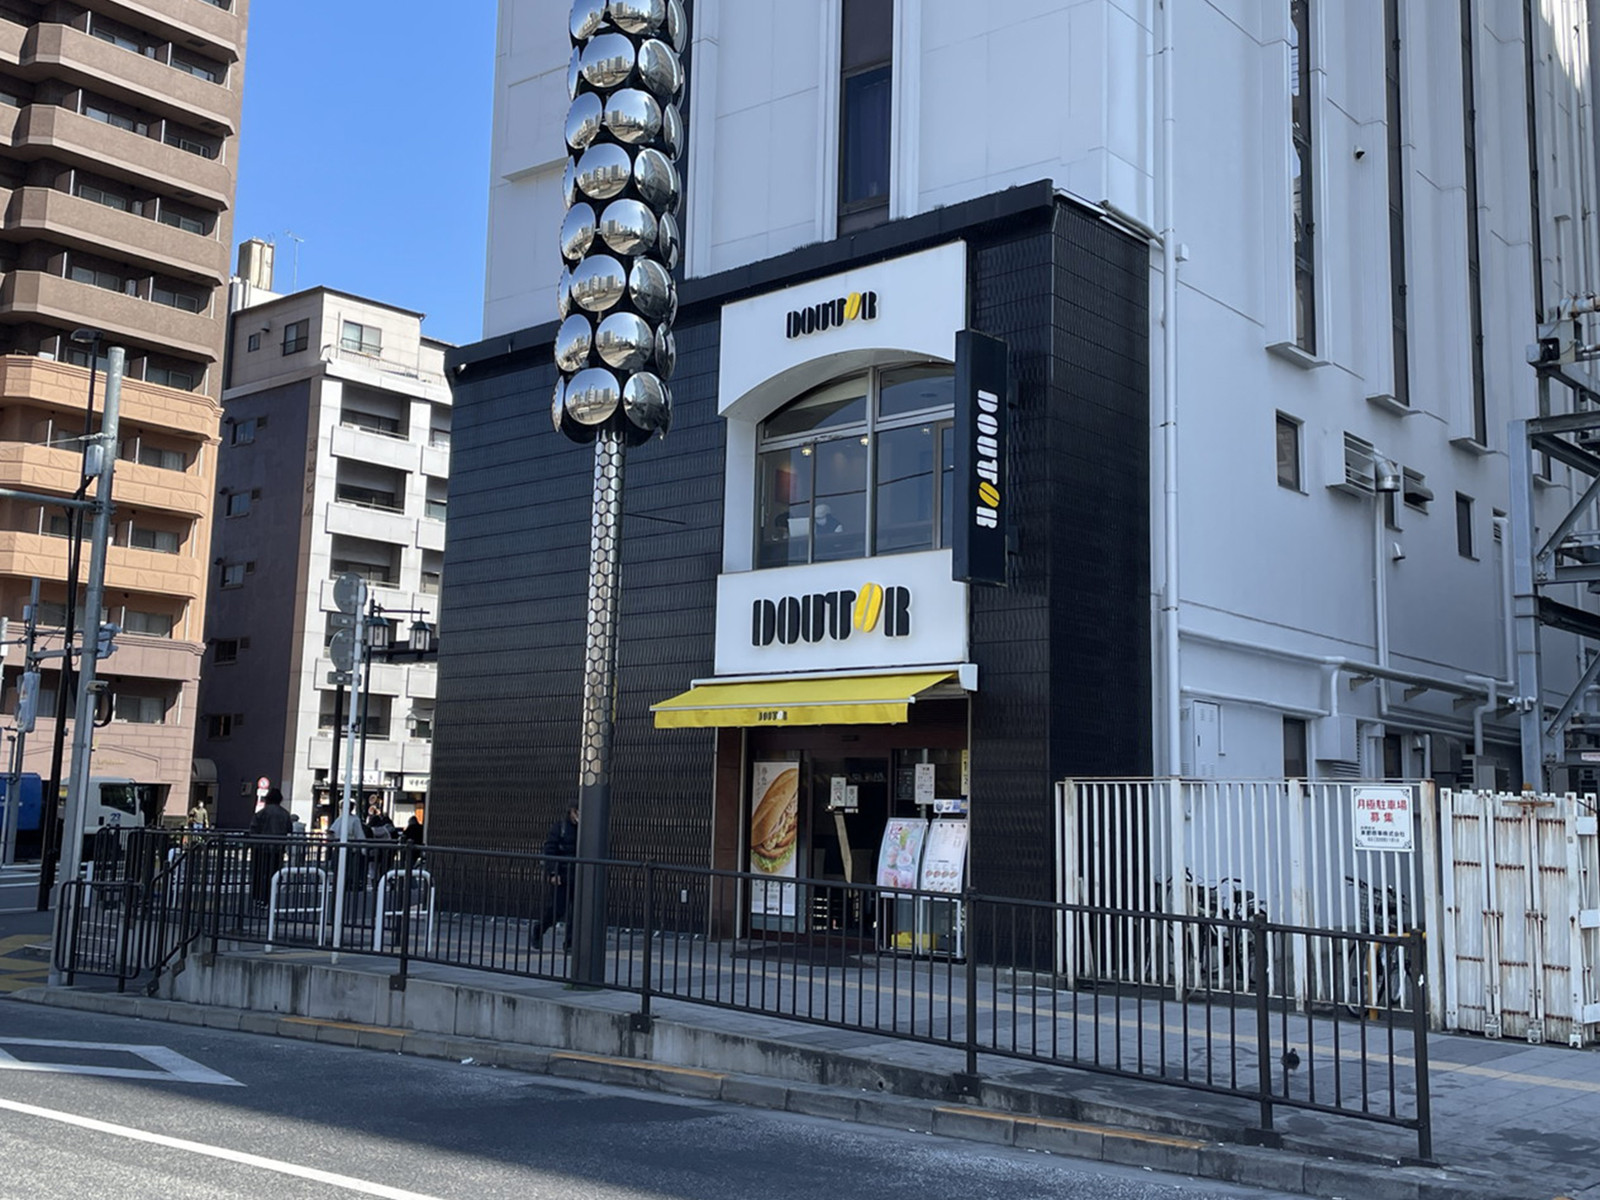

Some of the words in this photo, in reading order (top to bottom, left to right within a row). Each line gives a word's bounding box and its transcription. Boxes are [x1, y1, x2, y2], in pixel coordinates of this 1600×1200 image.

[786, 291, 877, 339] DOUTOR
[976, 389, 1000, 529] DOUTOR
[752, 582, 911, 646] DOUTOR
[1357, 798, 1407, 810] 月極駐車場
